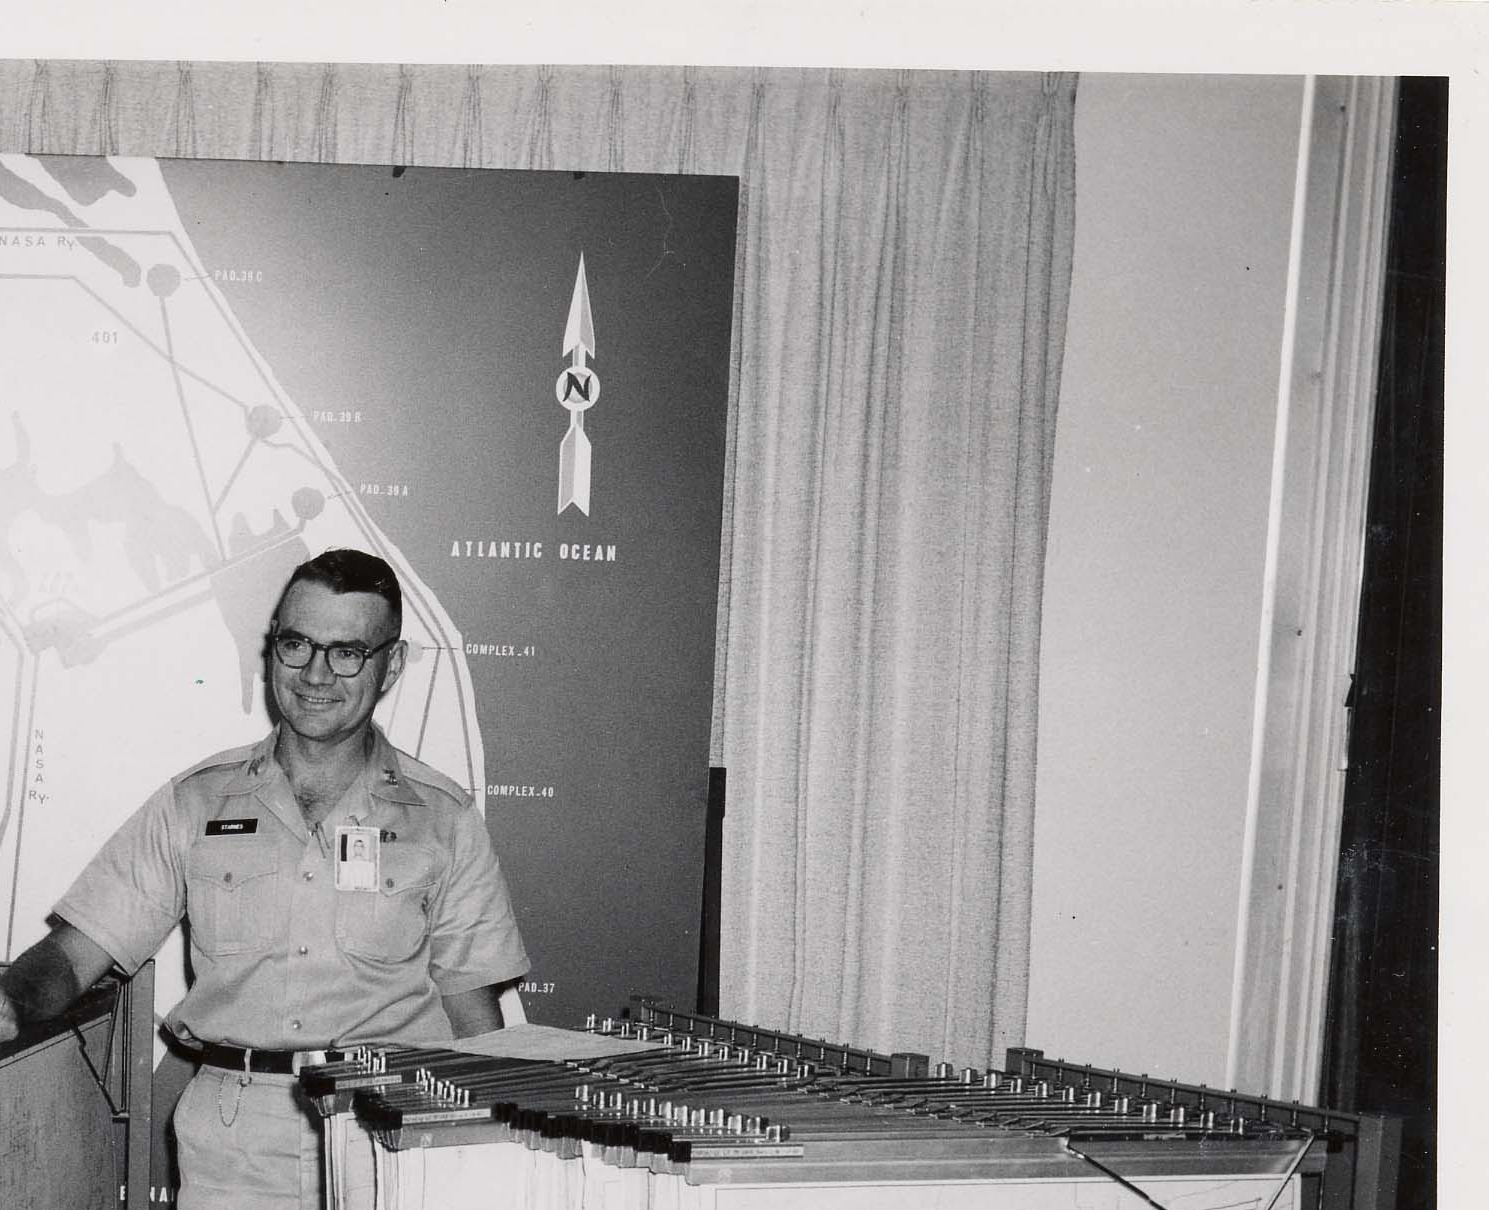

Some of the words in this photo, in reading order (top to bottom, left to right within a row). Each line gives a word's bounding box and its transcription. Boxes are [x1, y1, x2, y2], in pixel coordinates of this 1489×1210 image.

[0, 236, 45, 247] NASA
[92, 331, 117, 344] 401
[563, 373, 590, 402] N
[451, 541, 542, 558] ATLANTIC
[560, 544, 615, 561] OCEAN
